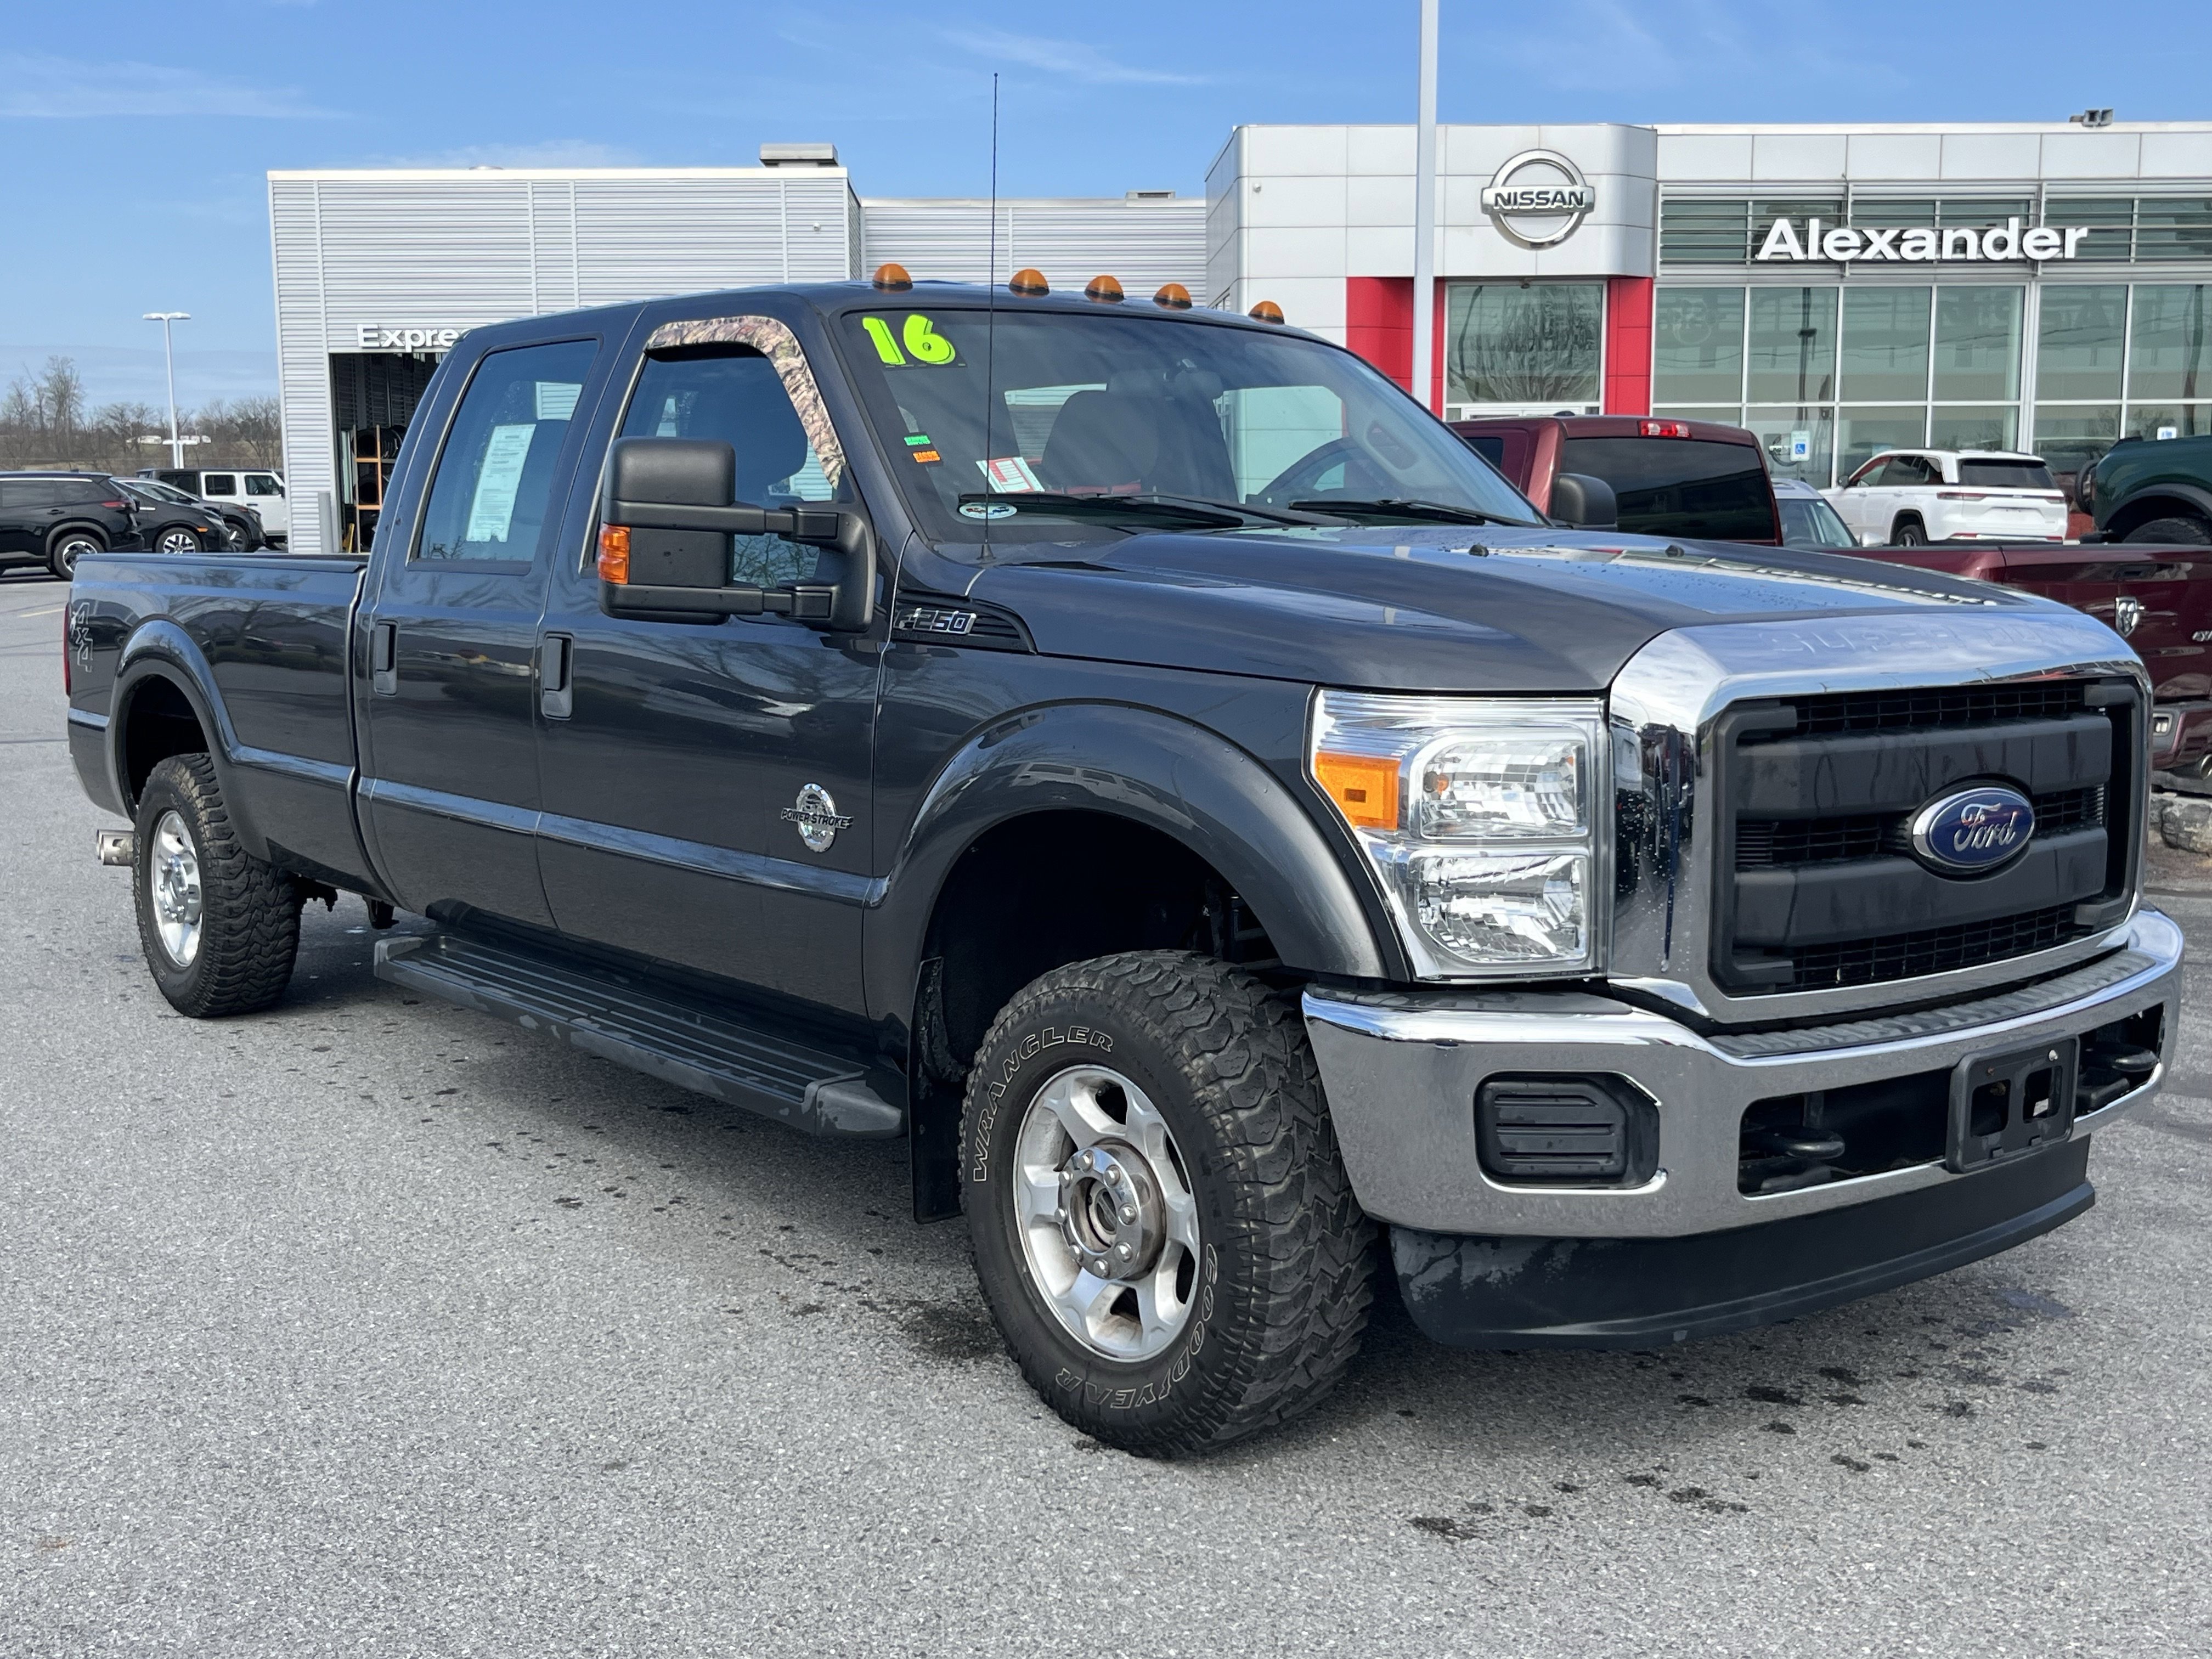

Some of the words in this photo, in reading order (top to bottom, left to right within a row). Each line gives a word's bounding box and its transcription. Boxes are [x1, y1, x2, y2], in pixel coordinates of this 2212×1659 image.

[1494, 191, 1584, 209] NISSAN
[1756, 218, 2088, 261] Alexander
[357, 324, 472, 352] Expre
[862, 314, 956, 365] 16
[1953, 803, 2016, 851] Ford
[973, 1025, 1114, 1182] WRANGLER
[1055, 1243, 1218, 1409] GOODYEAR
